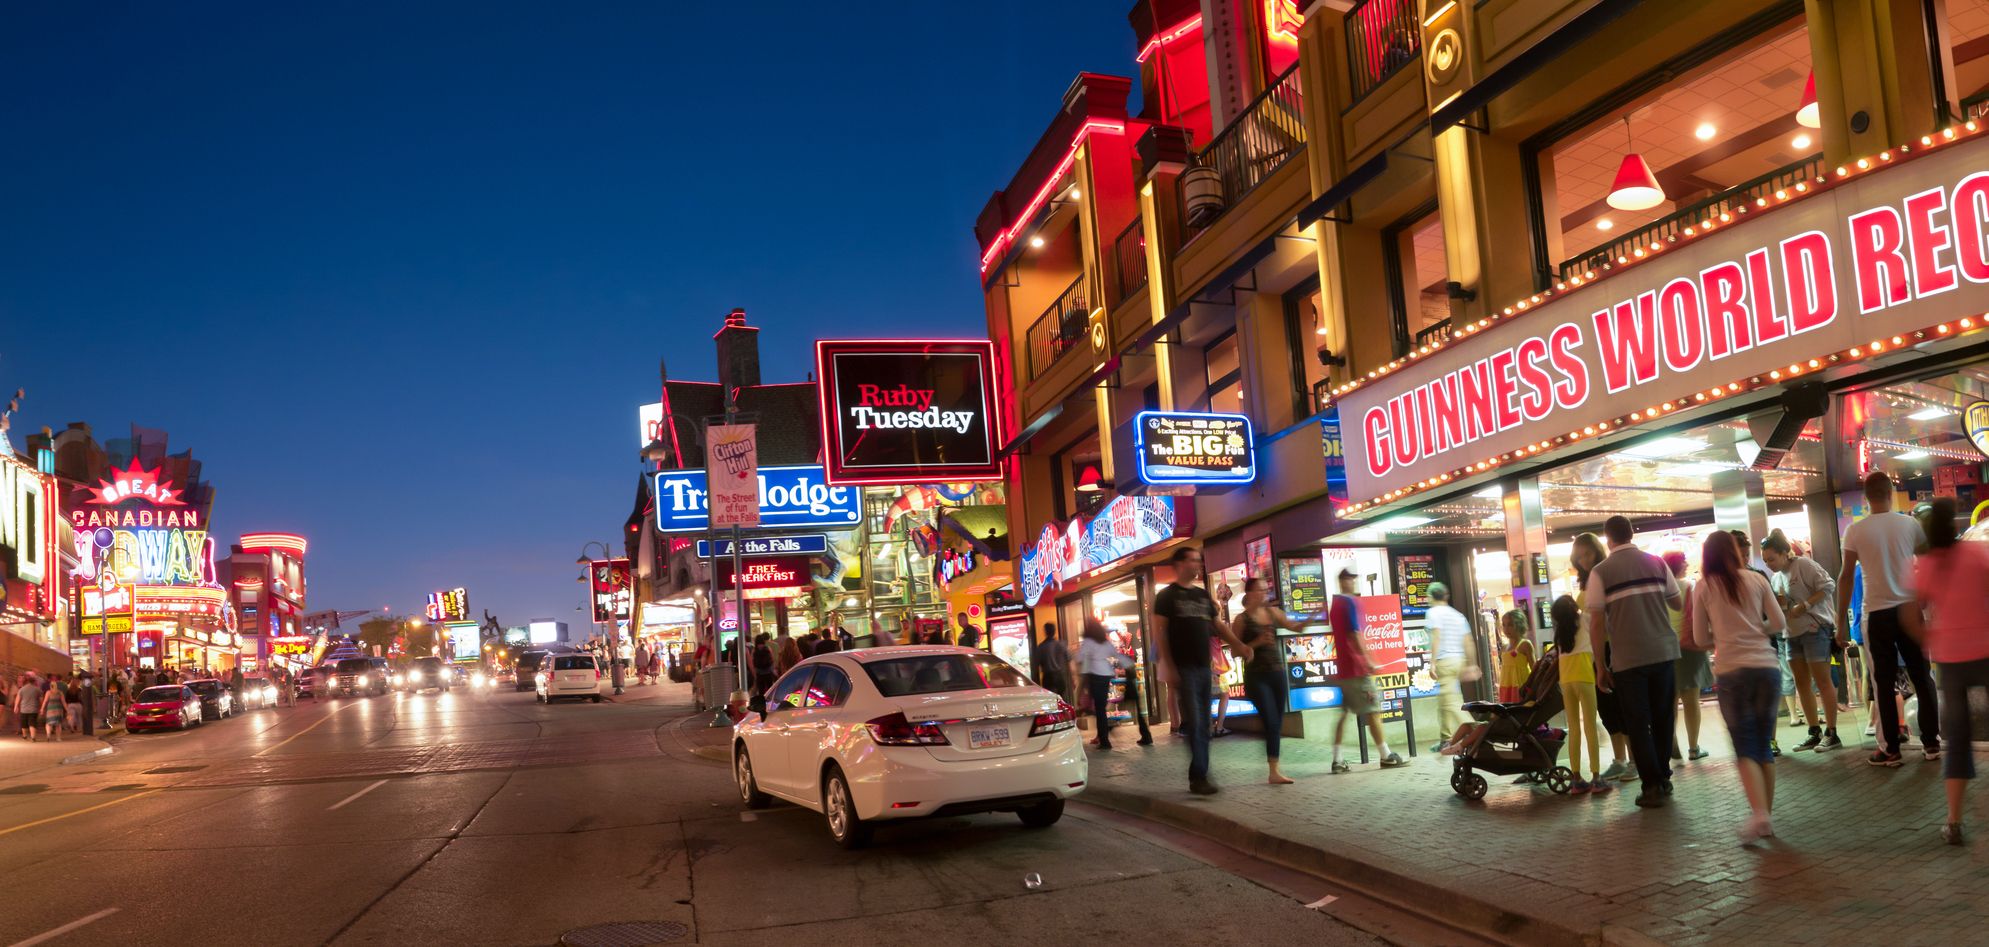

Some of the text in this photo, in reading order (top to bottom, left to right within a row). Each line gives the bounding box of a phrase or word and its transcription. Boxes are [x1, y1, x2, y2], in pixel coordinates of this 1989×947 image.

[1362, 320, 1590, 479] GUINNESS
[1592, 230, 1838, 395] WORLD
[858, 384, 935, 411] Ruby
[851, 406, 974, 434] Tuesday
[713, 439, 753, 461] Clifton
[1152, 444, 1173, 455] The
[1172, 435, 1223, 456] BIG
[725, 453, 750, 475] Hill
[1166, 456, 1233, 466] VALUE PASS
[102, 479, 172, 502] GREAT
[717, 493, 755, 503] The Street
[725, 503, 747, 512] of fun
[72, 510, 198, 527] CANADIAN
[717, 513, 757, 523] at the Falls
[725, 539, 800, 553] A the Falls
[749, 564, 777, 574] FREE
[1298, 575, 1314, 583] BIG
[1365, 612, 1397, 622] ice cold
[1366, 641, 1403, 650] sold here
[1322, 661, 1338, 675] Th
[1375, 674, 1405, 687] ATM
